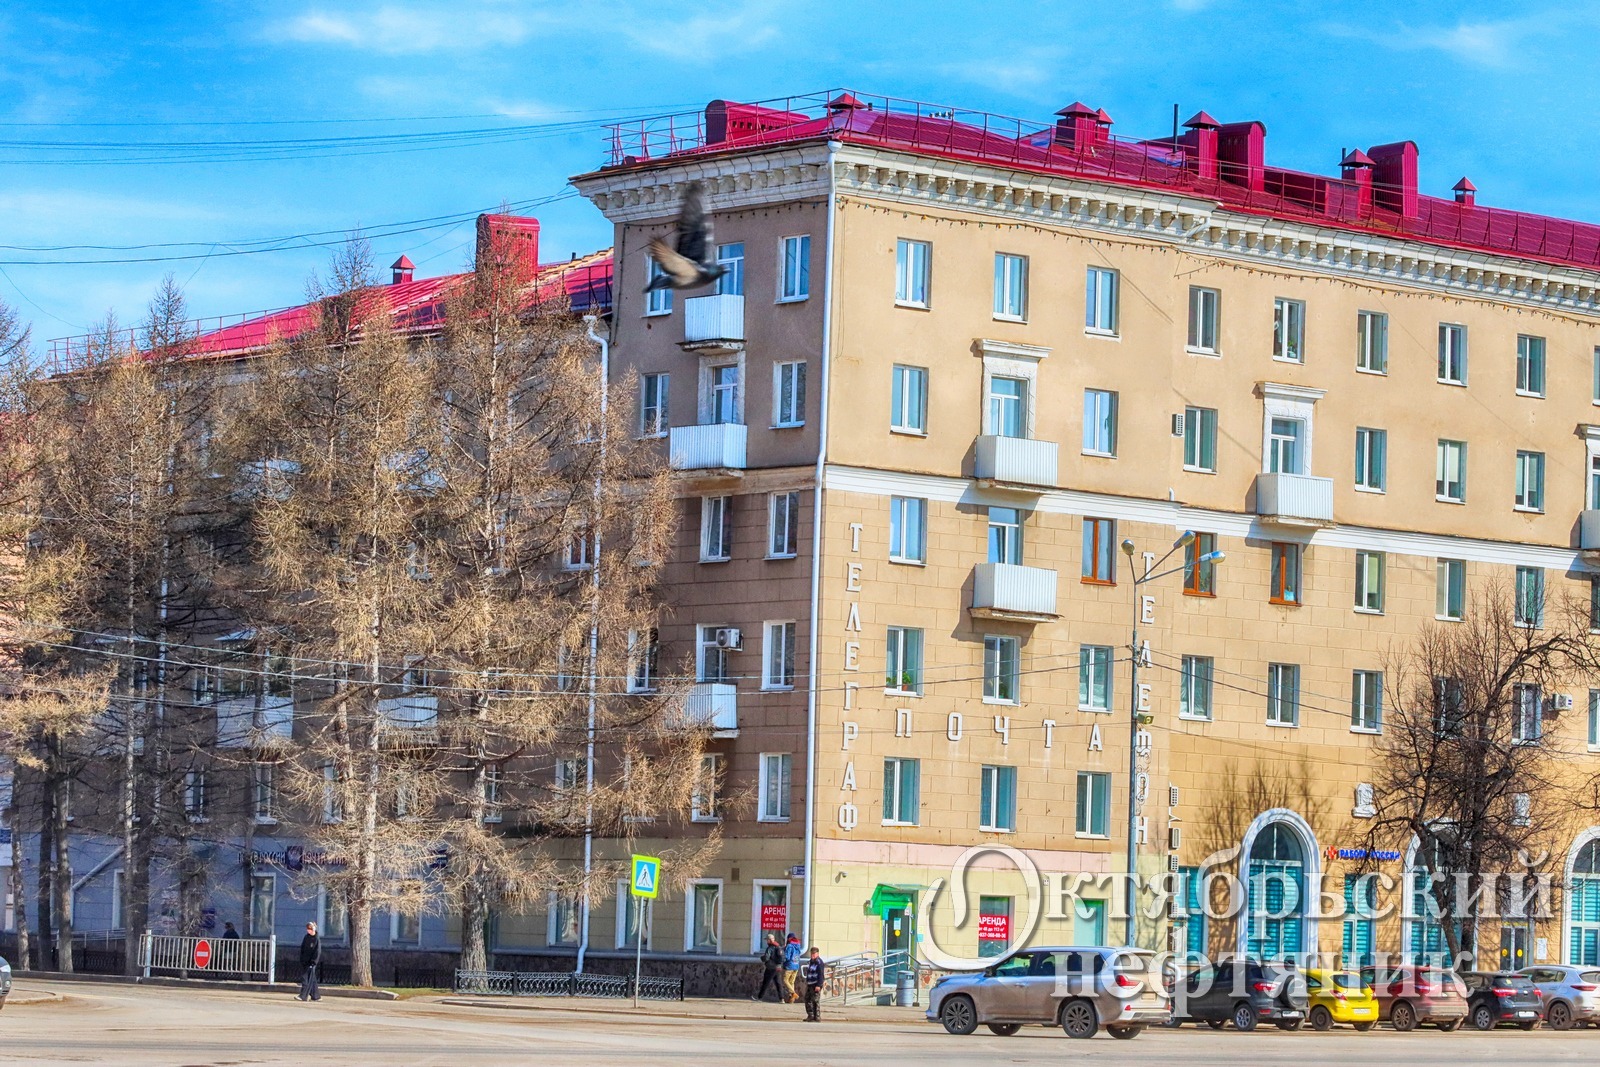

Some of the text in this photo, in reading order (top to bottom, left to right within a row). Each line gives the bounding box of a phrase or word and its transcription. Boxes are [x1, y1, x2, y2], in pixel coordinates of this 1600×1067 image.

[838, 522, 864, 831] ТЕЛЕГРАФ
[895, 708, 1104, 752] ПОЧТА
[979, 916, 1006, 926] АРЕНДА
